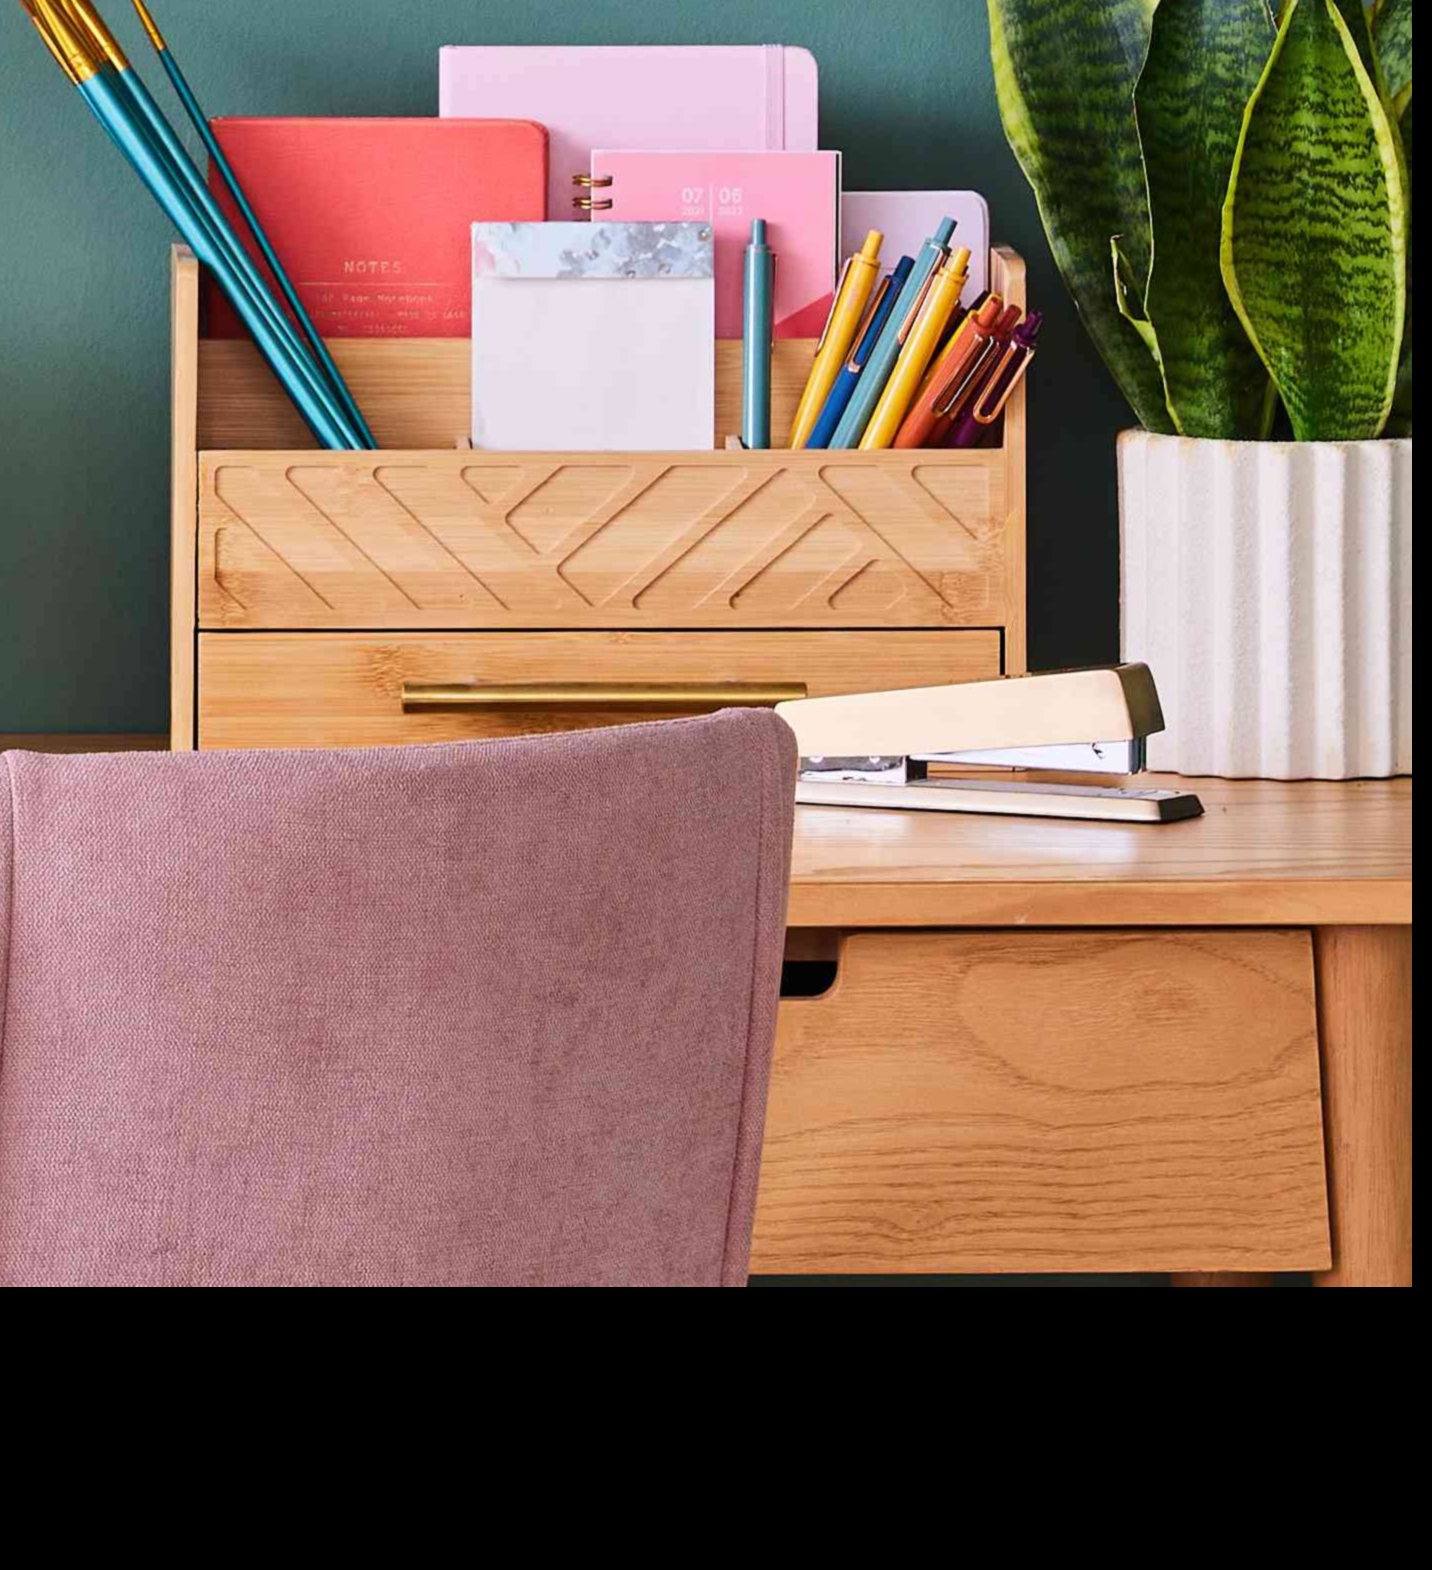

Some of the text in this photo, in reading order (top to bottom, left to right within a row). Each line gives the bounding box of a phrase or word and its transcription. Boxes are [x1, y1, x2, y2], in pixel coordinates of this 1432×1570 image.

[681, 187, 743, 204] 07 06
[344, 261, 403, 274] NOTES
